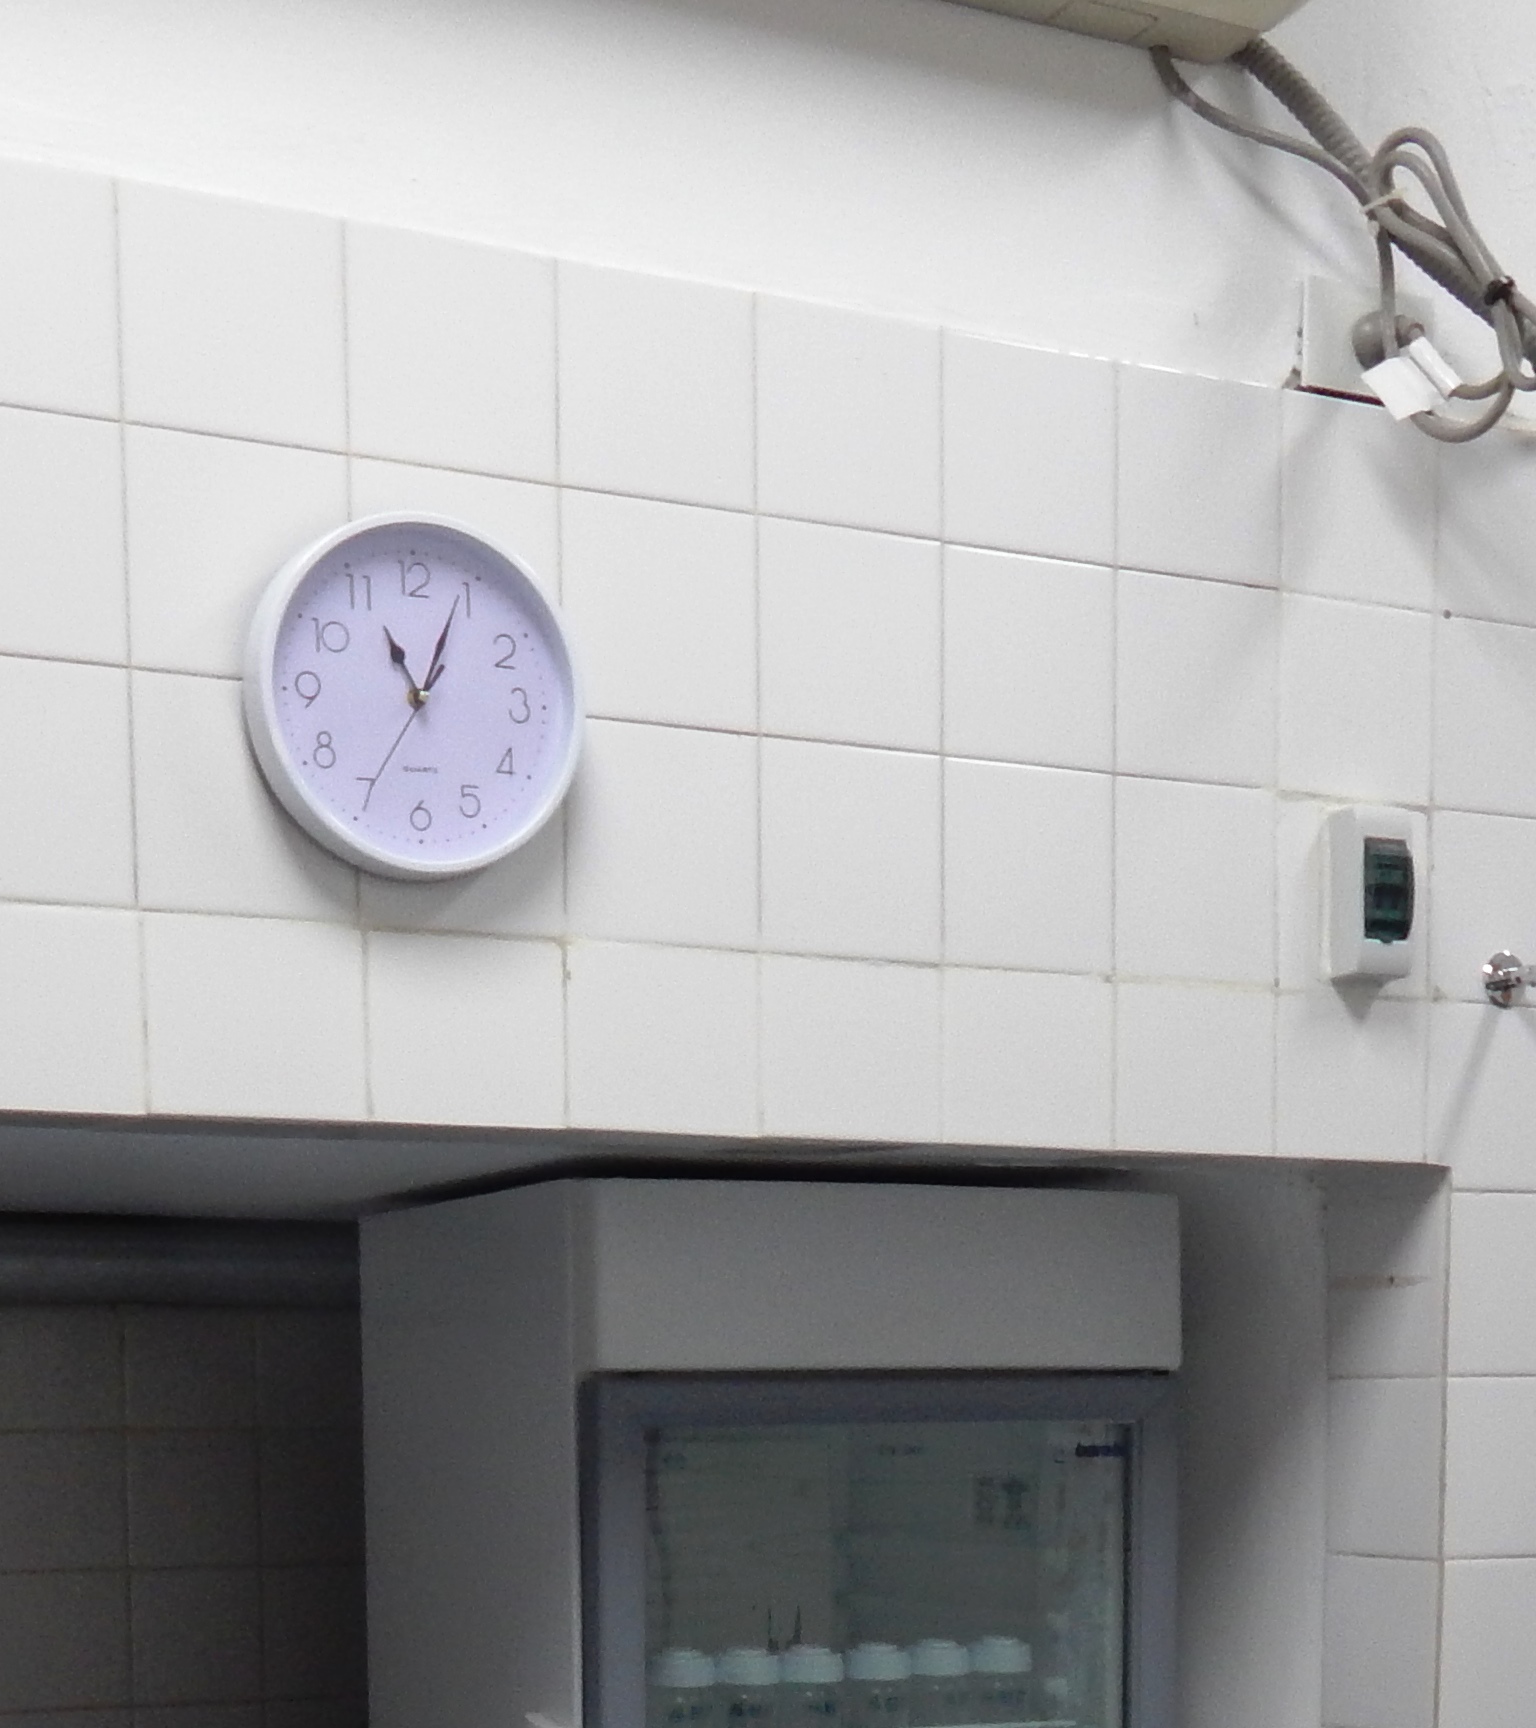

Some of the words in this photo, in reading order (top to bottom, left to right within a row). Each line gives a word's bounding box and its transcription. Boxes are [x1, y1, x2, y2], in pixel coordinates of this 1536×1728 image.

[346, 573, 372, 611] 11
[397, 559, 431, 599] 12
[461, 581, 471, 618] 1
[312, 617, 350, 653] 10
[492, 633, 517, 670] 2
[295, 671, 322, 708] 9
[508, 687, 531, 724] 3
[312, 730, 337, 769] 8
[496, 746, 516, 776] 4
[356, 776, 377, 812] 7
[459, 784, 482, 818] 5
[409, 799, 432, 831] 6
